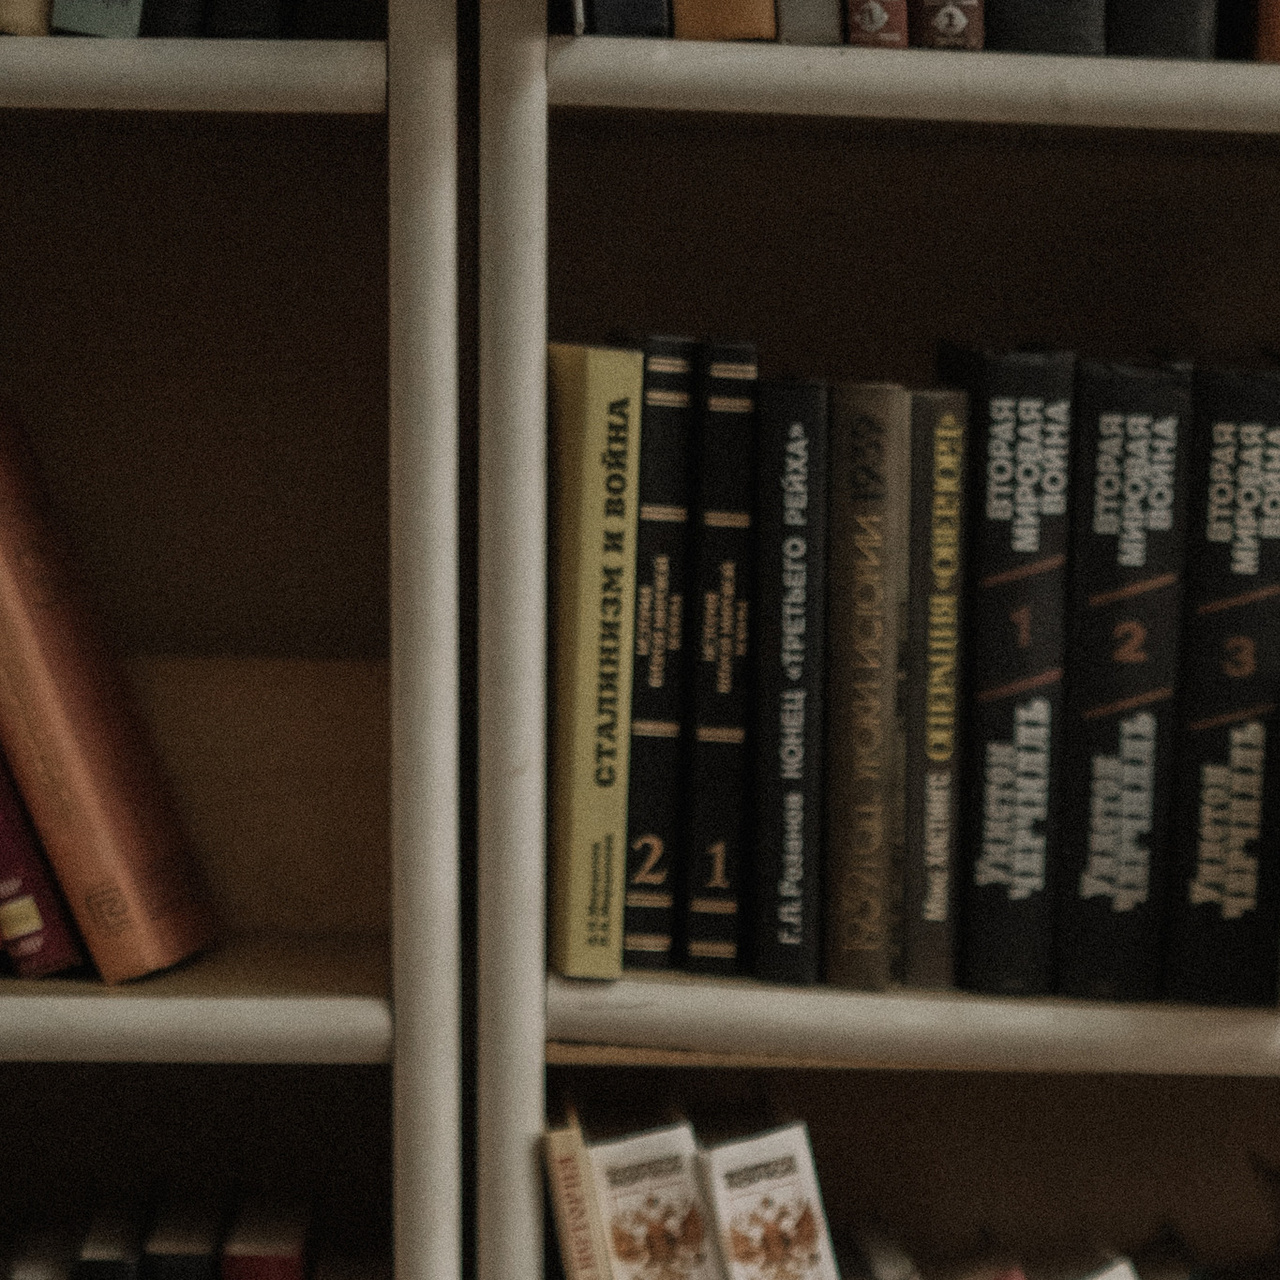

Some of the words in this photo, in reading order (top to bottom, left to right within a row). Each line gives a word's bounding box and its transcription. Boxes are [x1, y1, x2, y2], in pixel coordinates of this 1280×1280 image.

[603, 397, 631, 518] ВОЙНА
[780, 423, 808, 526] РЕЙХА»
[929, 413, 961, 590] «ОВЕРЛОРД»
[984, 398, 1016, 520] ВТОРАЯ
[1011, 398, 1045, 553] МИРОВАЯ
[1040, 400, 1072, 515] ВОЙНА
[1092, 413, 1125, 535] ВТОРАЯ
[1116, 414, 1152, 568] МИРОВАЯ
[1146, 416, 1180, 531] ВОЙНА
[1206, 421, 1239, 543] ВТОРАЯ
[1230, 422, 1265, 576] МИРОВАЯ
[602, 532, 624, 553] И
[781, 537, 808, 680] «ТРЕТЬЕГО
[1008, 604, 1033, 650] 1
[1111, 619, 1148, 663] 2
[1221, 635, 1255, 679] 3
[594, 566, 624, 788] СТАЛИНИЗМ
[780, 690, 807, 779] КОНЕЦ
[925, 594, 957, 762] ОПЕРАЦИЯ
[630, 833, 667, 886] 2
[705, 841, 730, 888] 1
